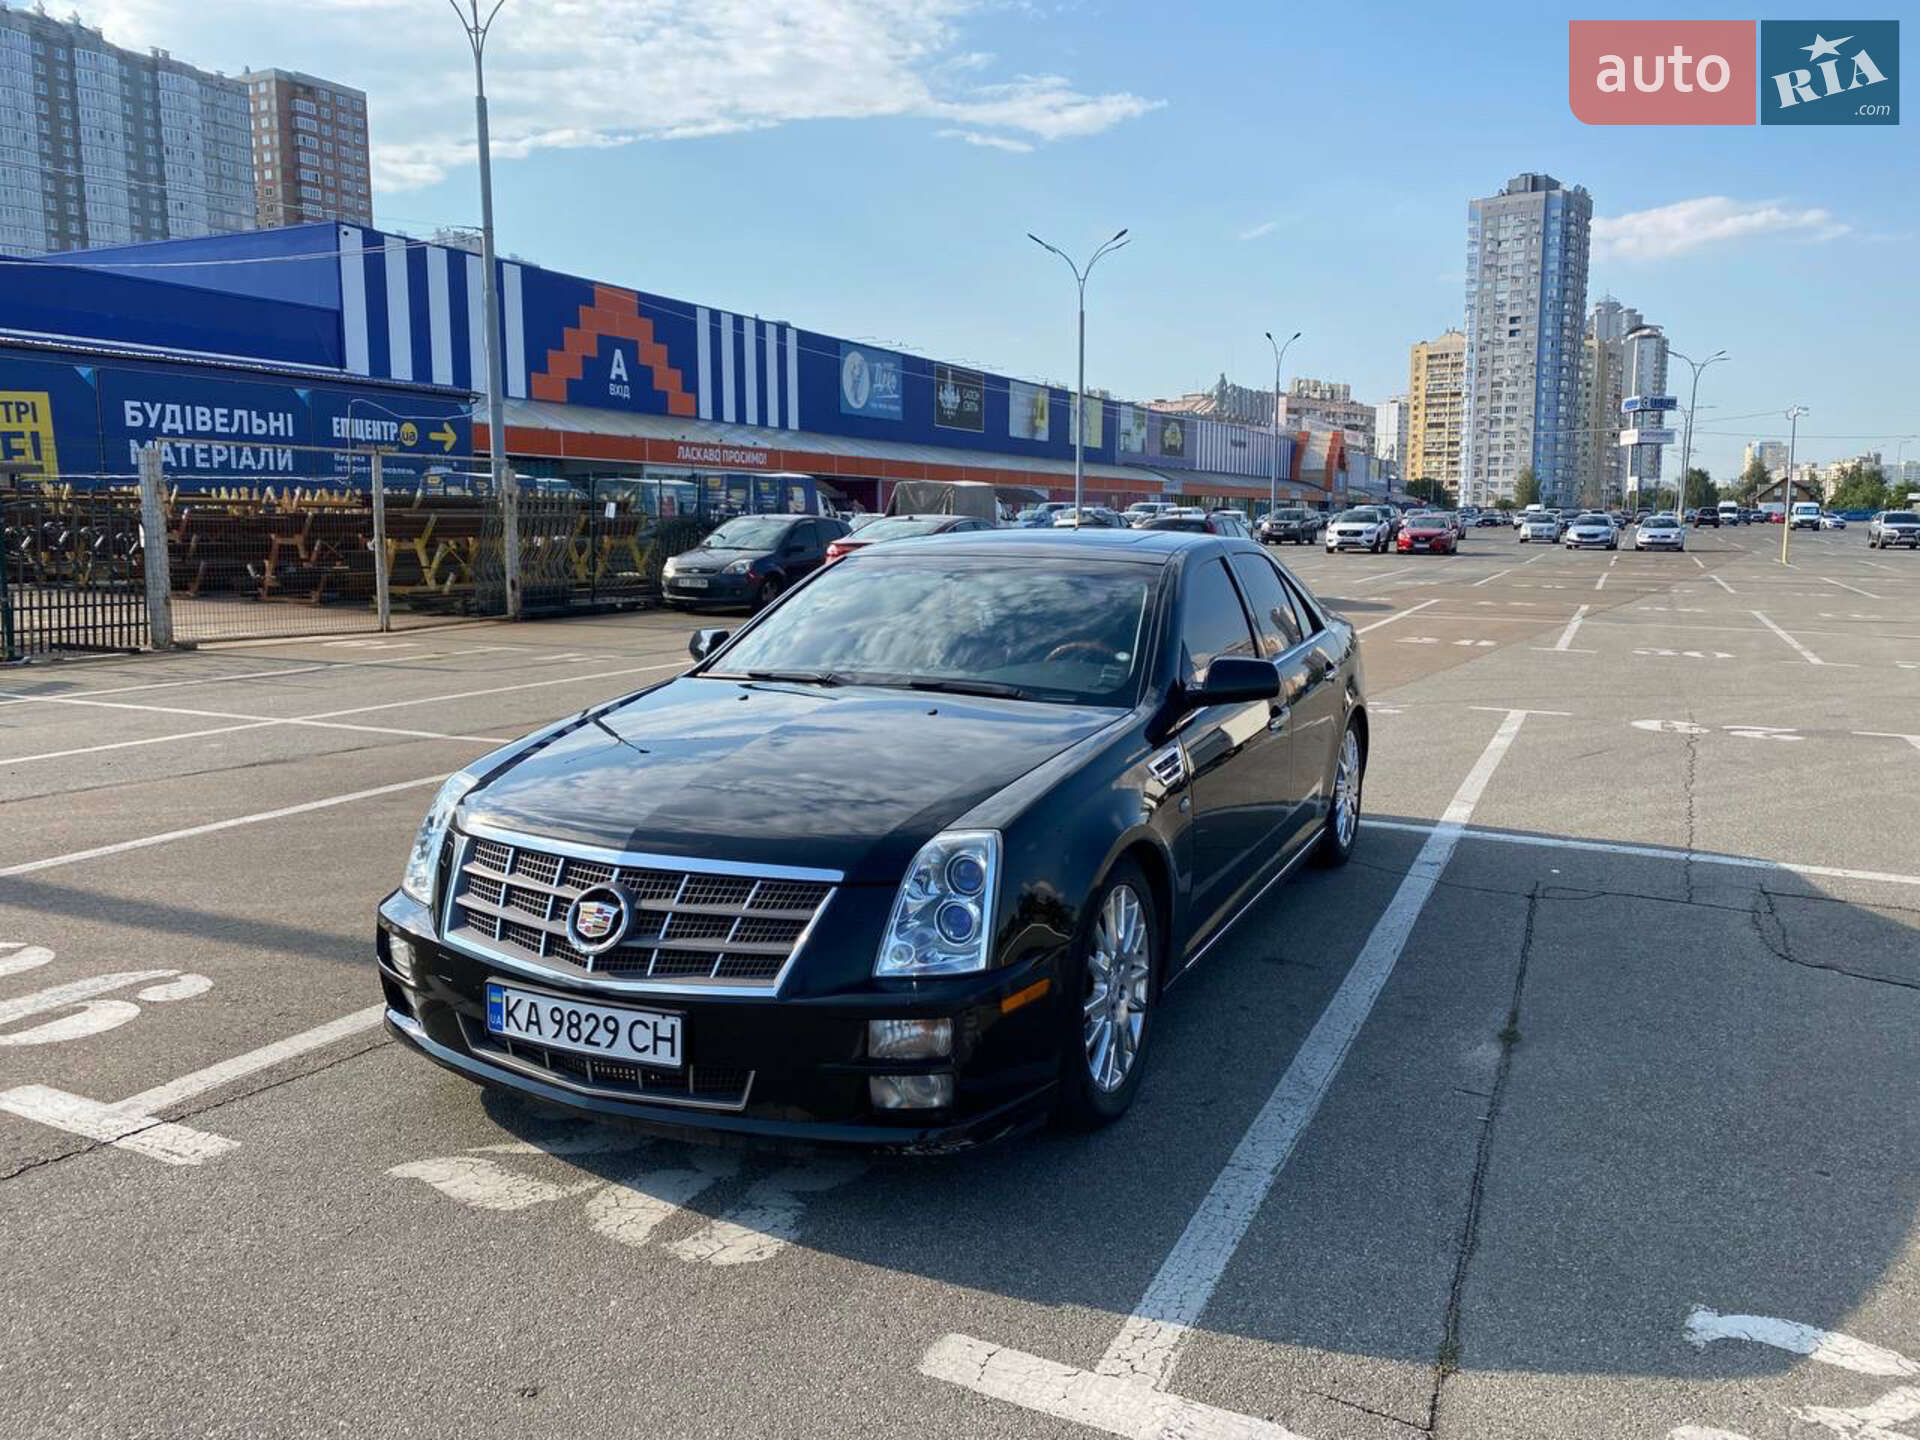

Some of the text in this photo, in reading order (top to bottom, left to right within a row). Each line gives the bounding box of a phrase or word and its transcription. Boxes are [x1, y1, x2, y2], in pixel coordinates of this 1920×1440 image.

[609, 383, 631, 400] ВХІД
[124, 400, 294, 437] БУДІВЕЛЬНІ
[677, 446, 768, 465] ЛАСКАВО ПРОСИМО!
[489, 1014, 502, 1025] UA
[505, 996, 676, 1058] KA 9829 CH
